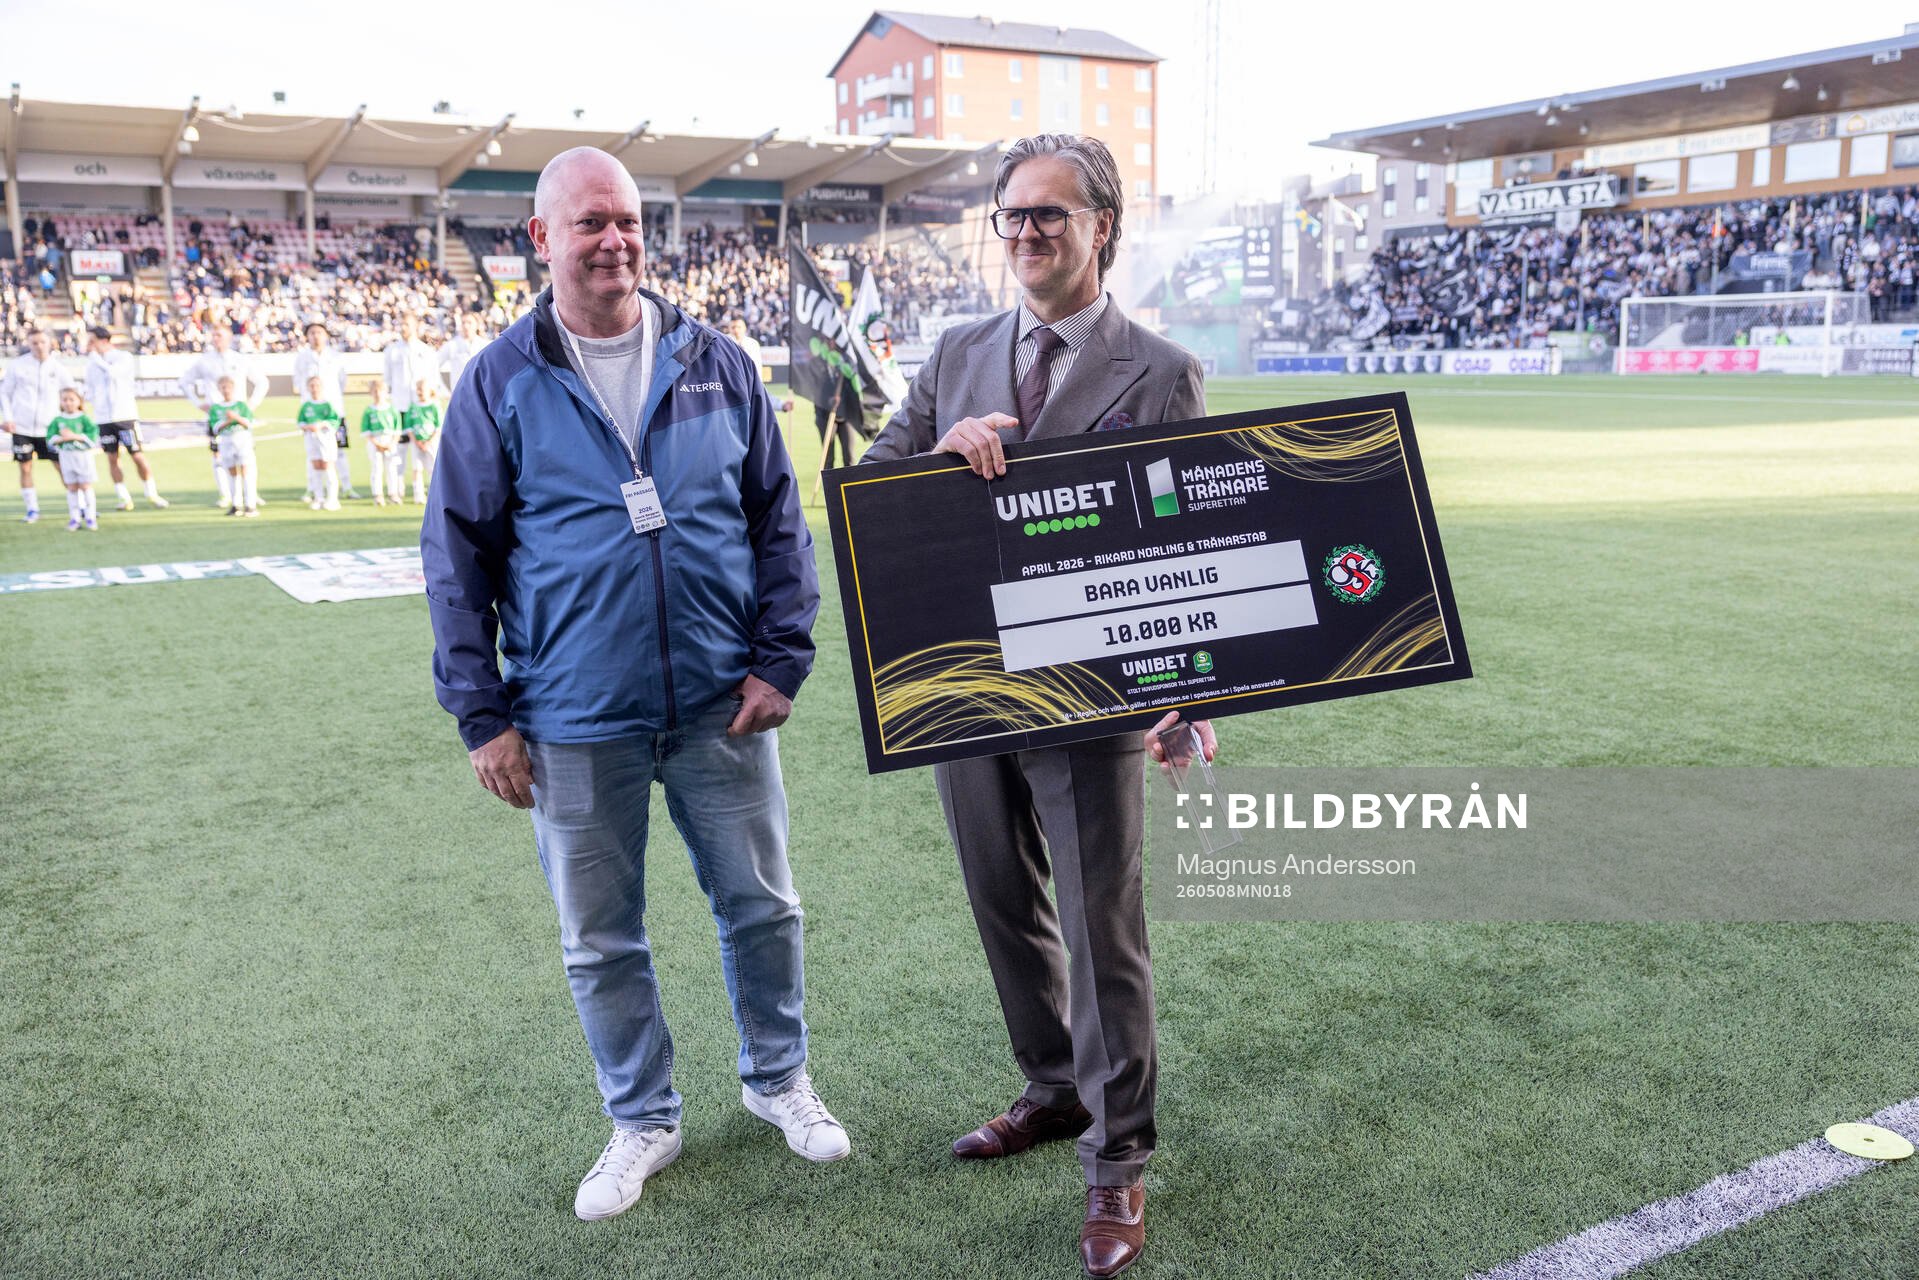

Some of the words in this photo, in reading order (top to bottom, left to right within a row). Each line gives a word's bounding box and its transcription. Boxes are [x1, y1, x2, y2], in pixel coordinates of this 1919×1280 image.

[74, 162, 108, 176] och
[203, 167, 277, 182] växande
[1181, 460, 1265, 483] MÅNADENS
[1183, 475, 1269, 501] TRÄNARE
[638, 505, 653, 514] 2026
[995, 480, 1117, 521] UNIBET
[1188, 496, 1247, 512] SUPERETTAN
[1022, 562, 1055, 577] APRIL
[1056, 557, 1085, 572] 2026
[1094, 550, 1136, 566] RIKARD
[1137, 543, 1185, 560] NORLING
[1186, 541, 1196, 552] &
[1196, 531, 1267, 550] TRÄNARSTAB
[1084, 578, 1141, 602] BARA
[1145, 567, 1219, 592] VANLIG
[1103, 616, 1182, 646] 10.000
[1187, 611, 1218, 633] KR
[1121, 653, 1187, 677] UNIBET
[1127, 687, 1141, 695] STOLT
[1187, 675, 1216, 686] SUPERETTAN
[1077, 710, 1097, 719] Regler
[1098, 706, 1110, 714] och
[1110, 703, 1129, 712] villkor
[1129, 700, 1147, 710] gäller
[1151, 694, 1190, 706] stödlinjen.se
[1193, 688, 1229, 700] spelpaus.se
[1232, 685, 1250, 694] Spela
[1250, 679, 1286, 690] ansvarsfullt
